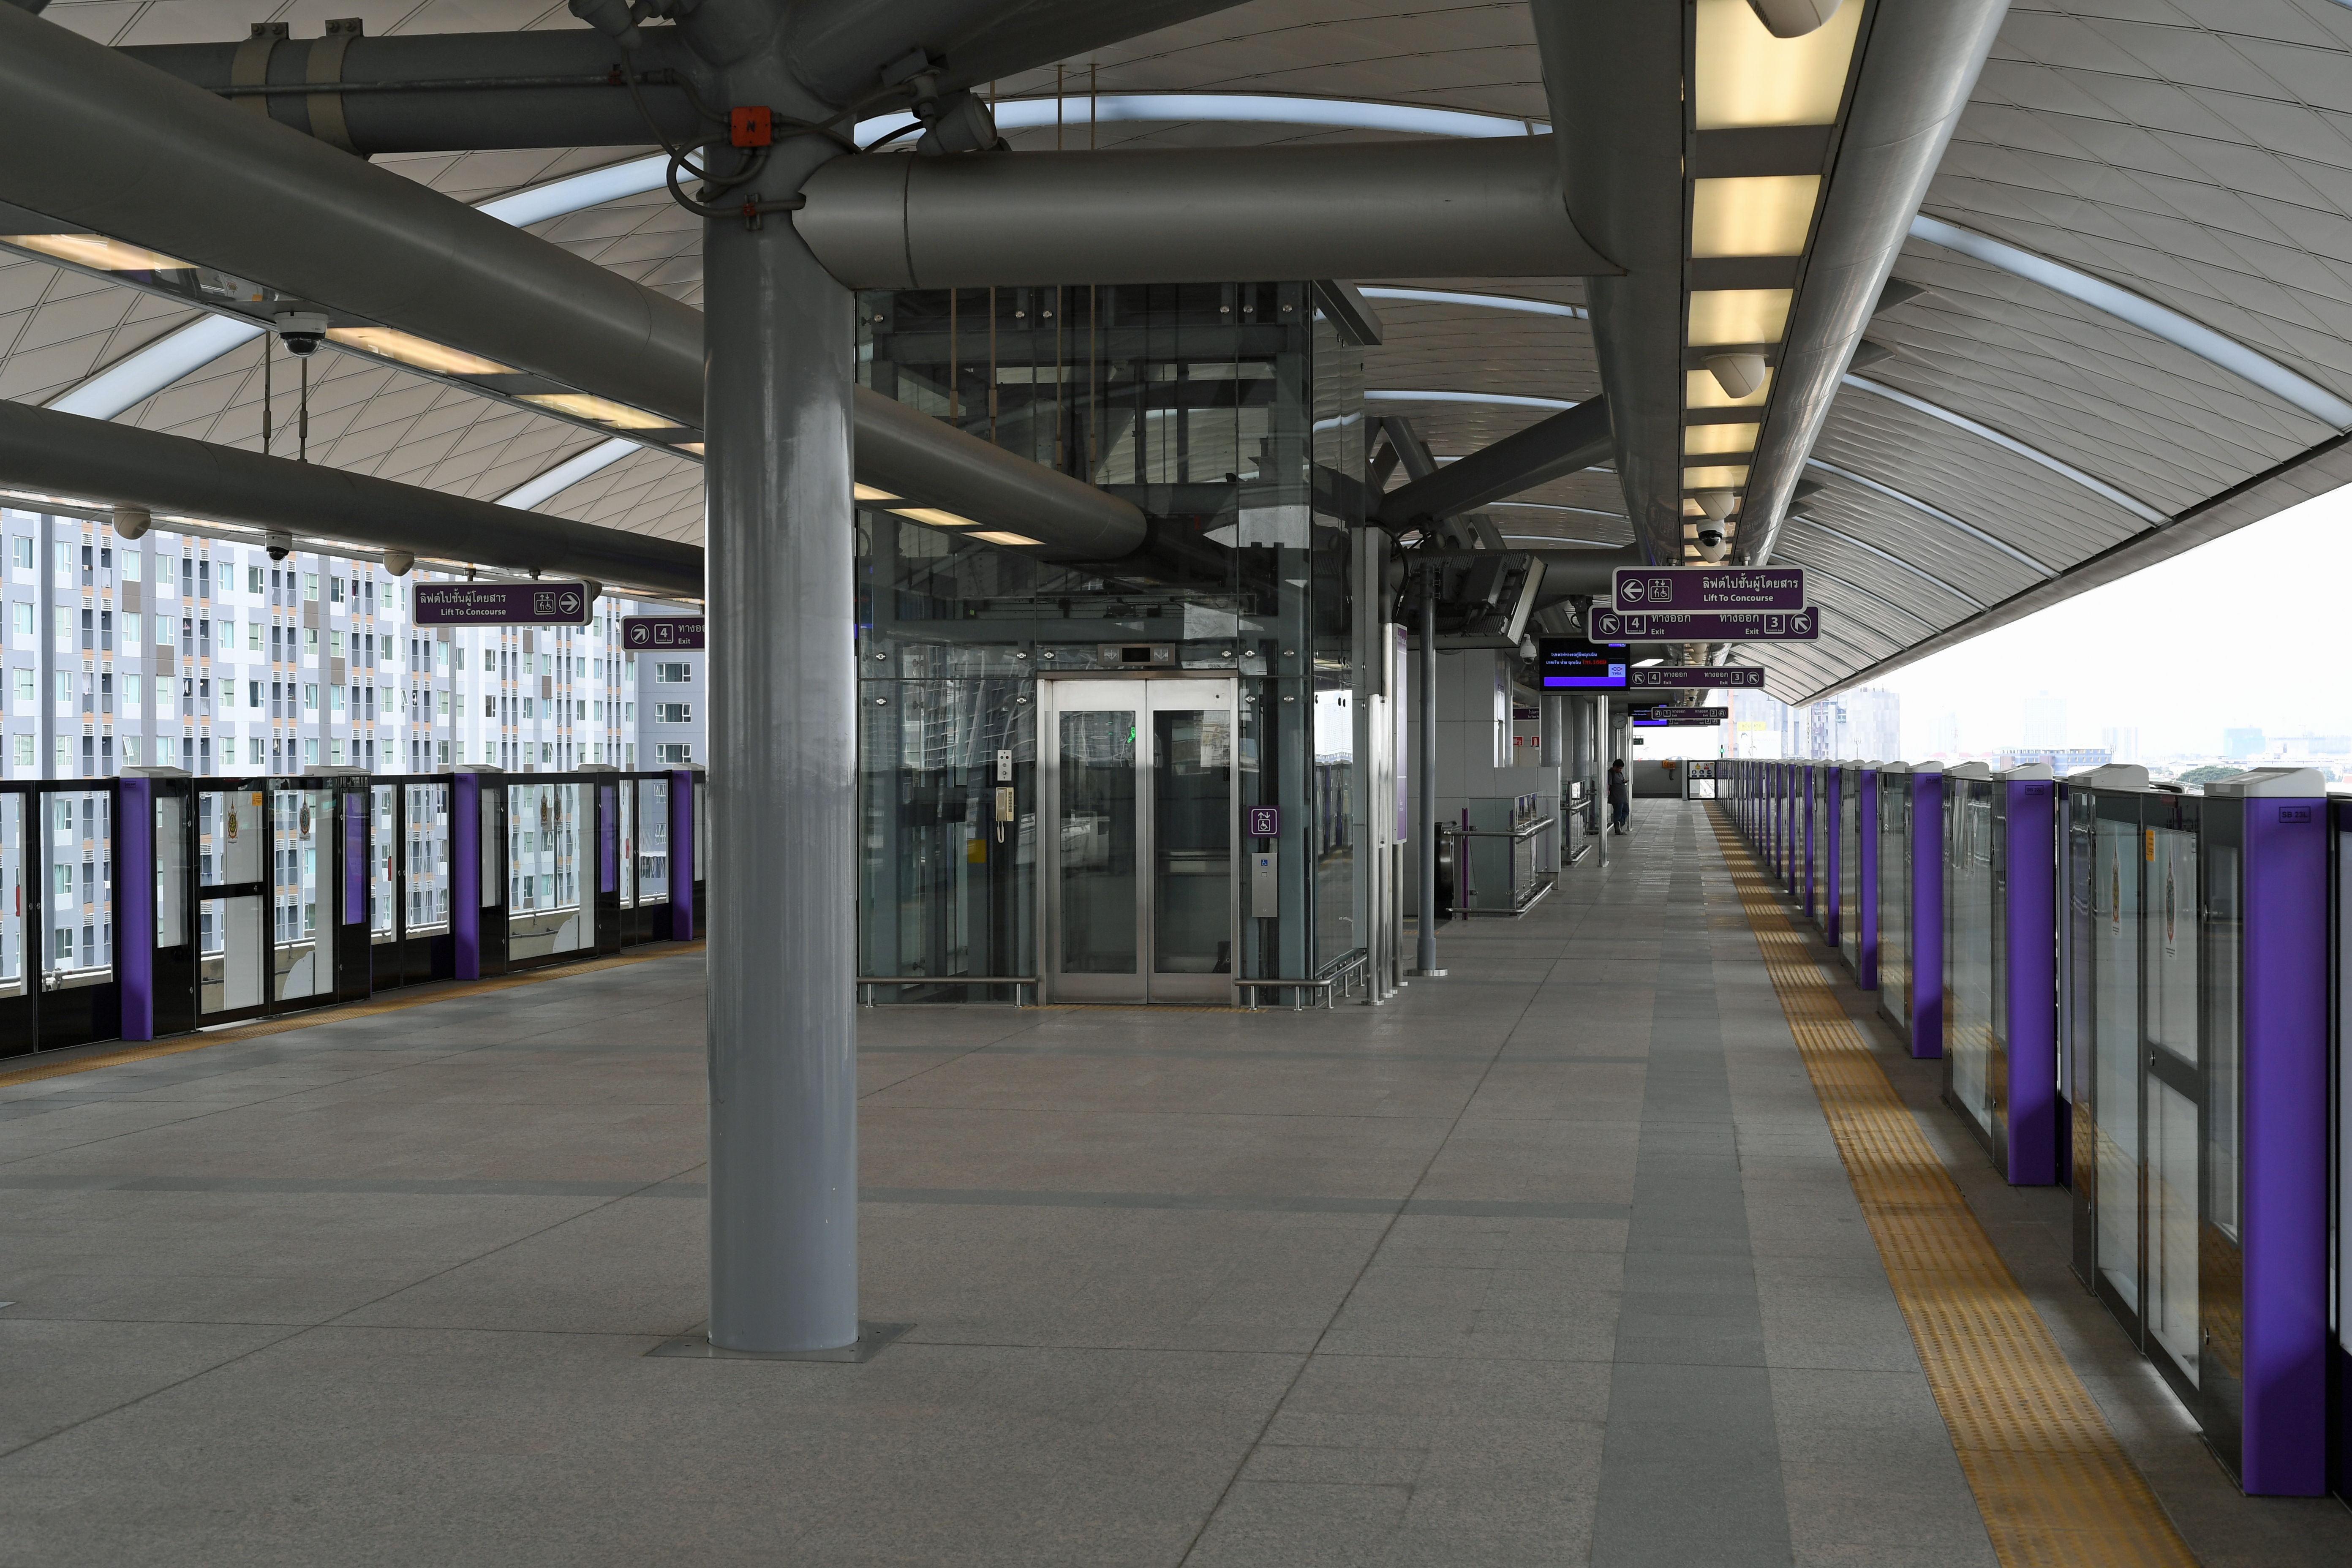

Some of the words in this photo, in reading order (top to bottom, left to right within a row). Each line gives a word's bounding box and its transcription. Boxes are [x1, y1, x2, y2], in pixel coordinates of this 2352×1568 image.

[1703, 572, 1799, 592] ลิฟต์ไปชั้นผู้โดยสาร
[420, 588, 506, 606] ลิฟต์ไปชั้นผู้โดยสาร
[1631, 617, 1640, 628] 4
[1719, 614, 1759, 622] ทางออก
[1771, 617, 1778, 627] 3
[660, 628, 668, 638] 4
